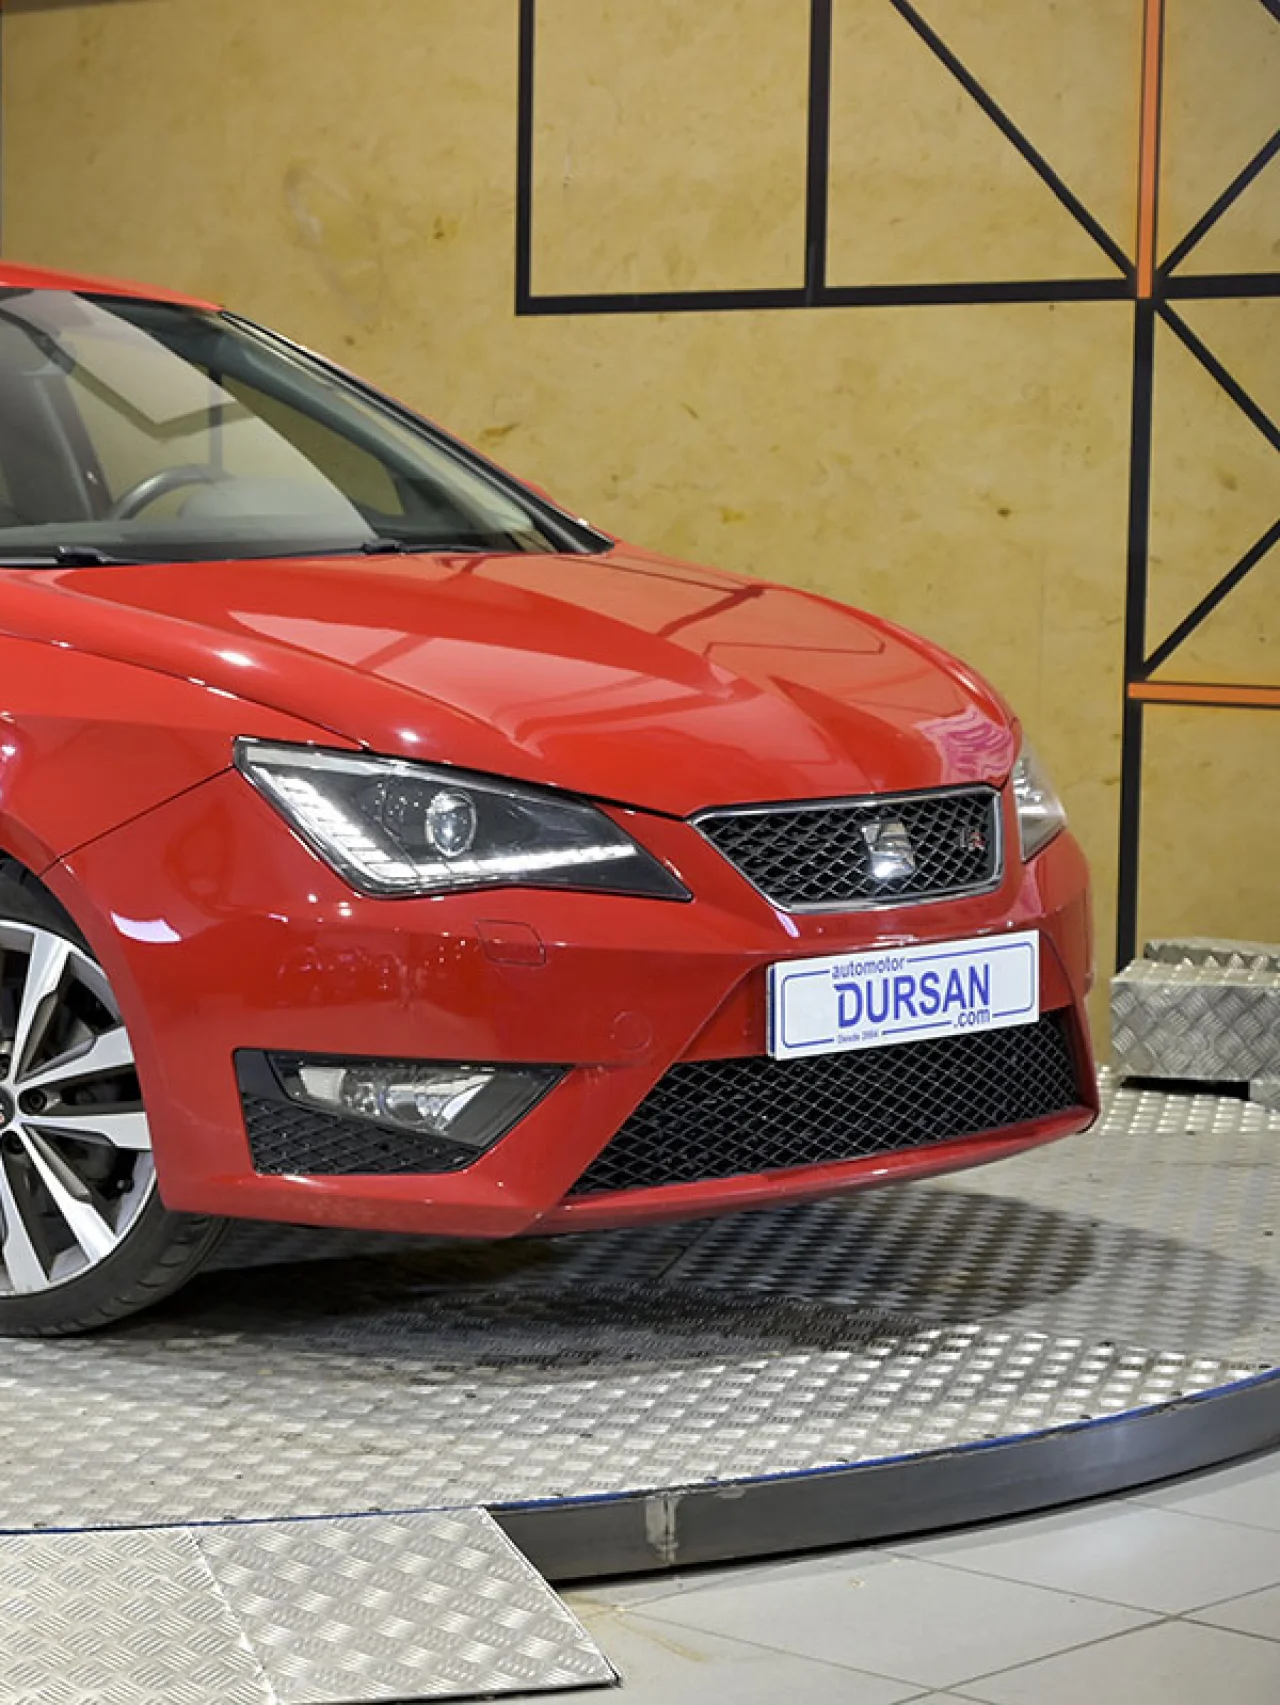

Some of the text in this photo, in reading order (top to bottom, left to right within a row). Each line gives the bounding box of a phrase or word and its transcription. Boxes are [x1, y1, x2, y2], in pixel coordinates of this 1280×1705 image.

[831, 956, 906, 979] automotor
[832, 963, 991, 1029] DURSAN
[953, 1008, 991, 1029] .com
